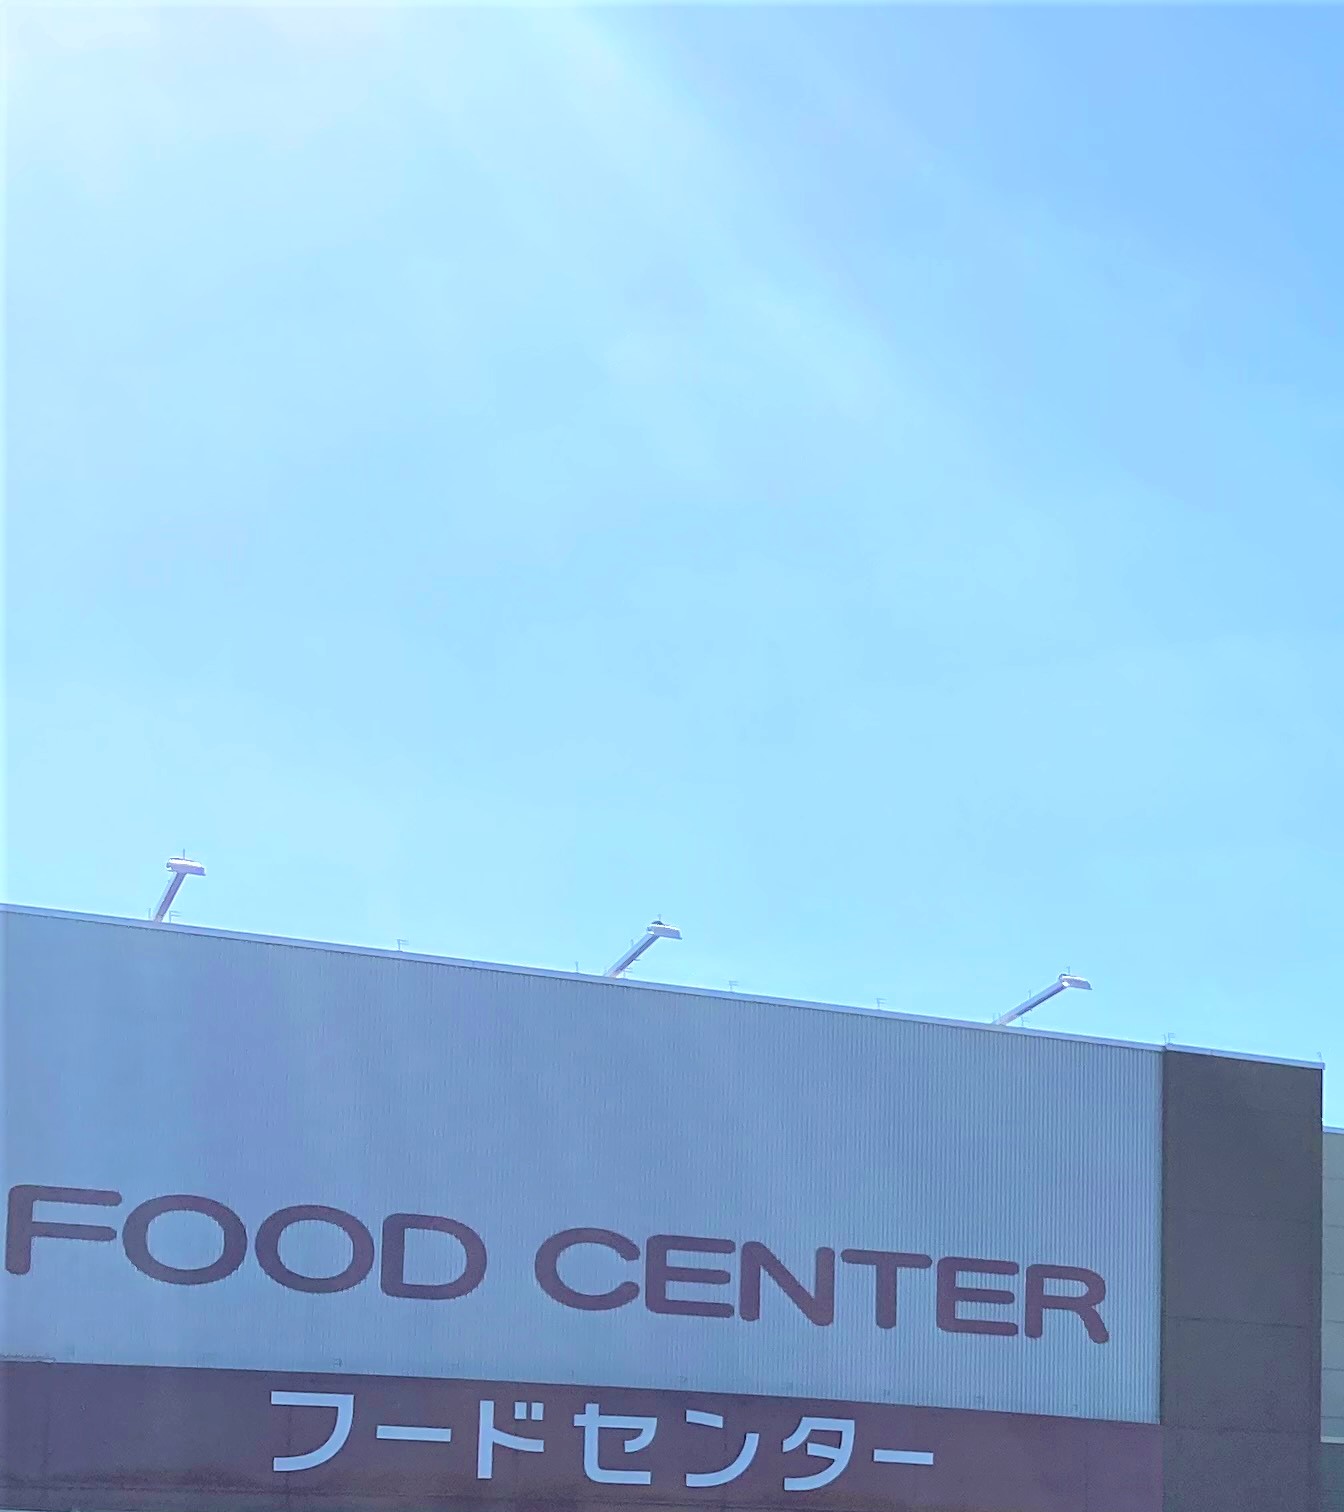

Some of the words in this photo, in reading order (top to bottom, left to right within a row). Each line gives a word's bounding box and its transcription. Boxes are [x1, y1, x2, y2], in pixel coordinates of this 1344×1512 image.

[5, 1183, 488, 1301] FOOD
[534, 1226, 1109, 1345] CENTER
[270, 1390, 935, 1492] フードセンター
